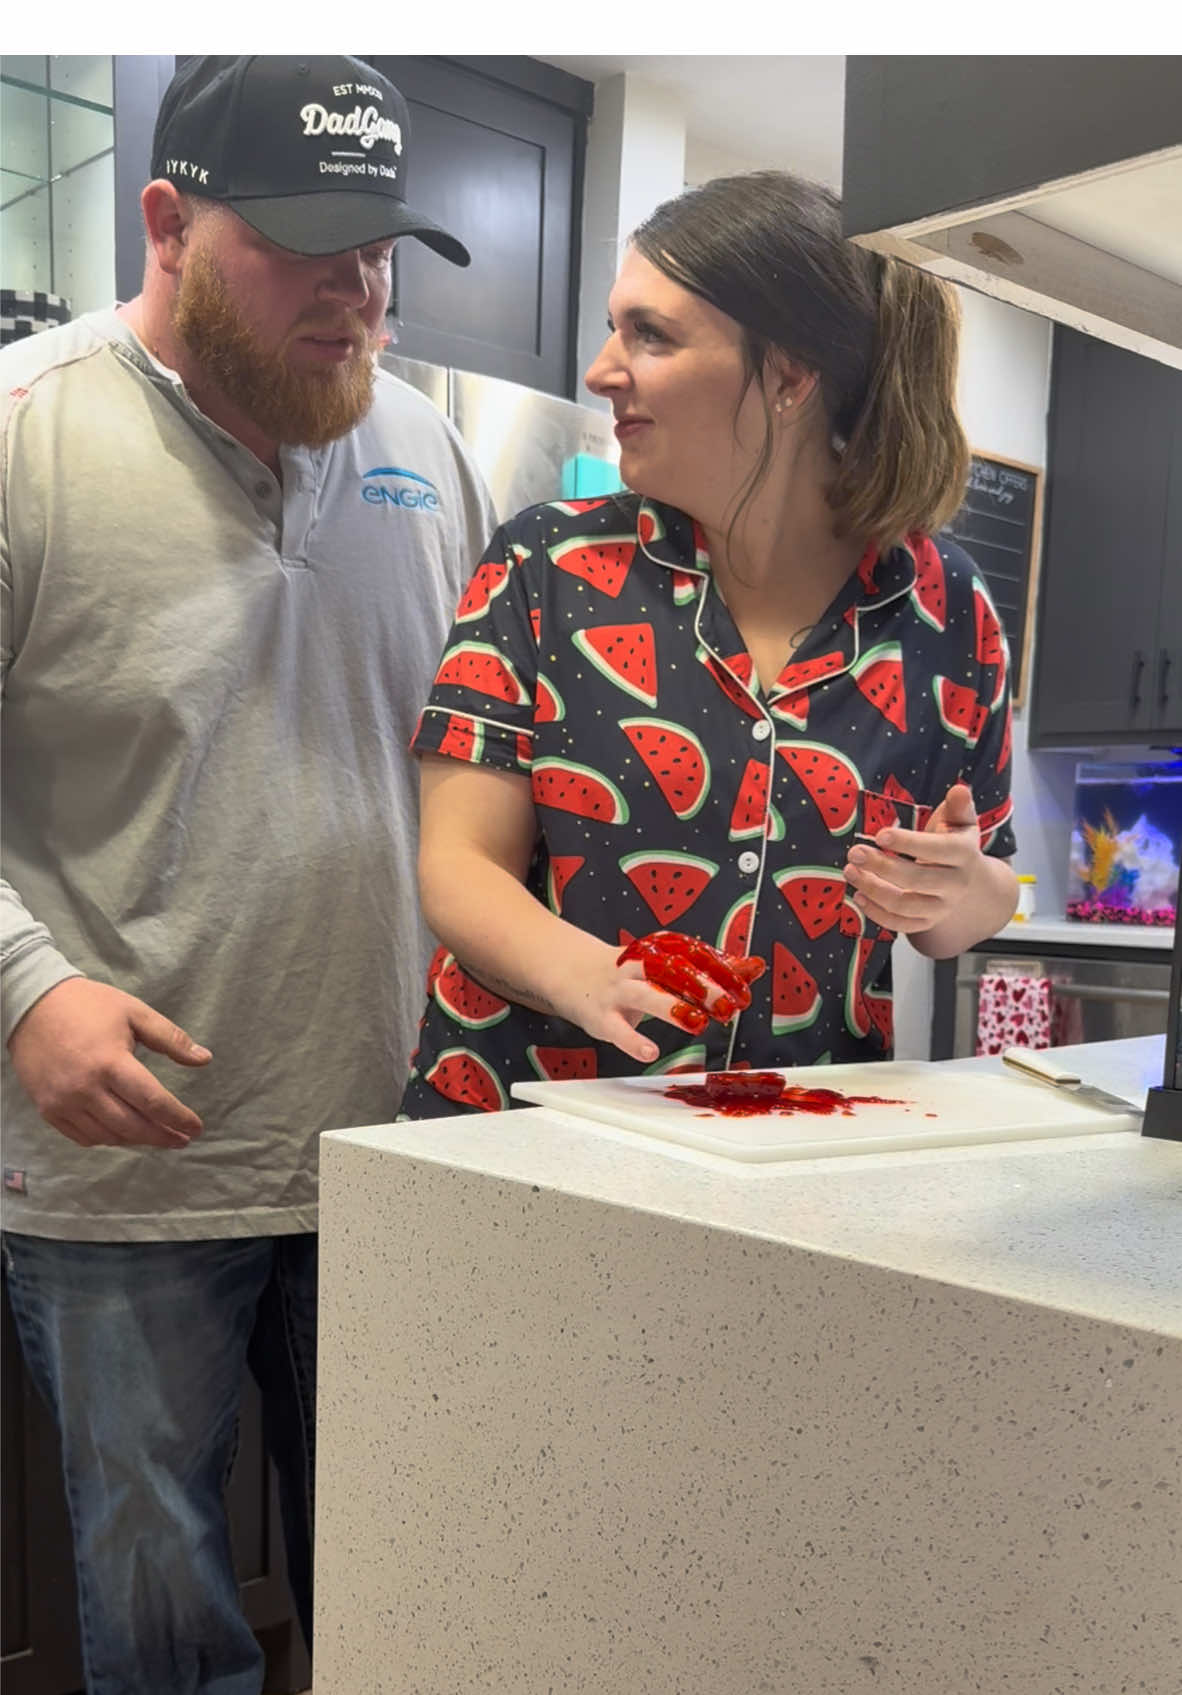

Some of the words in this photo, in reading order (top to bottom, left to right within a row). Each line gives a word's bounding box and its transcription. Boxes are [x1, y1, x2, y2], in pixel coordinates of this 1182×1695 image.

[333, 84, 353, 96] EST
[166, 159, 209, 185] IYKYK
[319, 161, 366, 176] Designed
[367, 163, 378, 178] by
